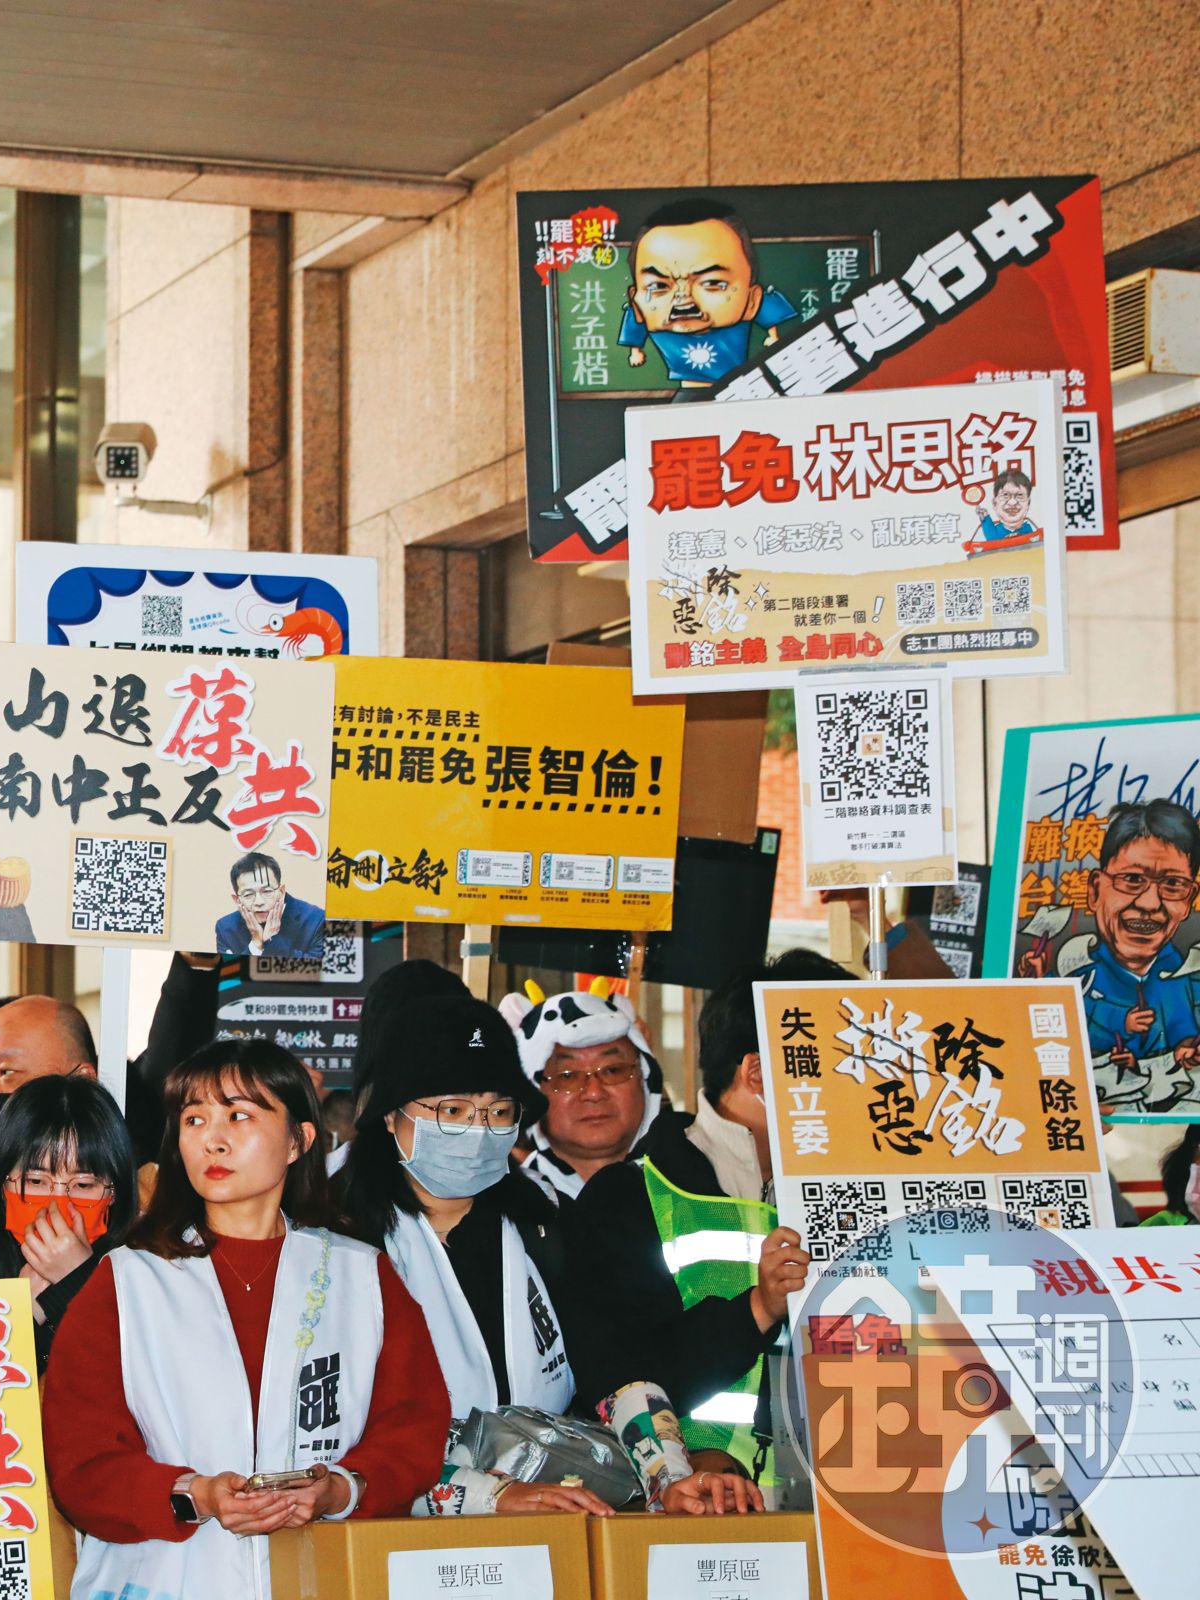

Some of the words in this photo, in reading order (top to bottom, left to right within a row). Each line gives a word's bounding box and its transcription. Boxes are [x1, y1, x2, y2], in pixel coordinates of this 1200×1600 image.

[569, 280, 609, 386] 洪孟楷
[650, 429, 800, 514] 罷免
[803, 410, 1038, 502] 林思銘
[763, 594, 850, 613] 第二階段連署
[663, 637, 769, 669] 刪銘主義
[777, 631, 884, 662] 全島同心
[906, 630, 1034, 652] 志工團熱烈招募中
[823, 803, 933, 819] 二階聯絡資料調查表
[780, 1007, 830, 1156] 失職立委
[1028, 1003, 1086, 1152] 國會除銘
[1030, 1254, 1200, 1297] 親共
[437, 1562, 504, 1589] 豐原區
[696, 1558, 762, 1583] 豐原區
